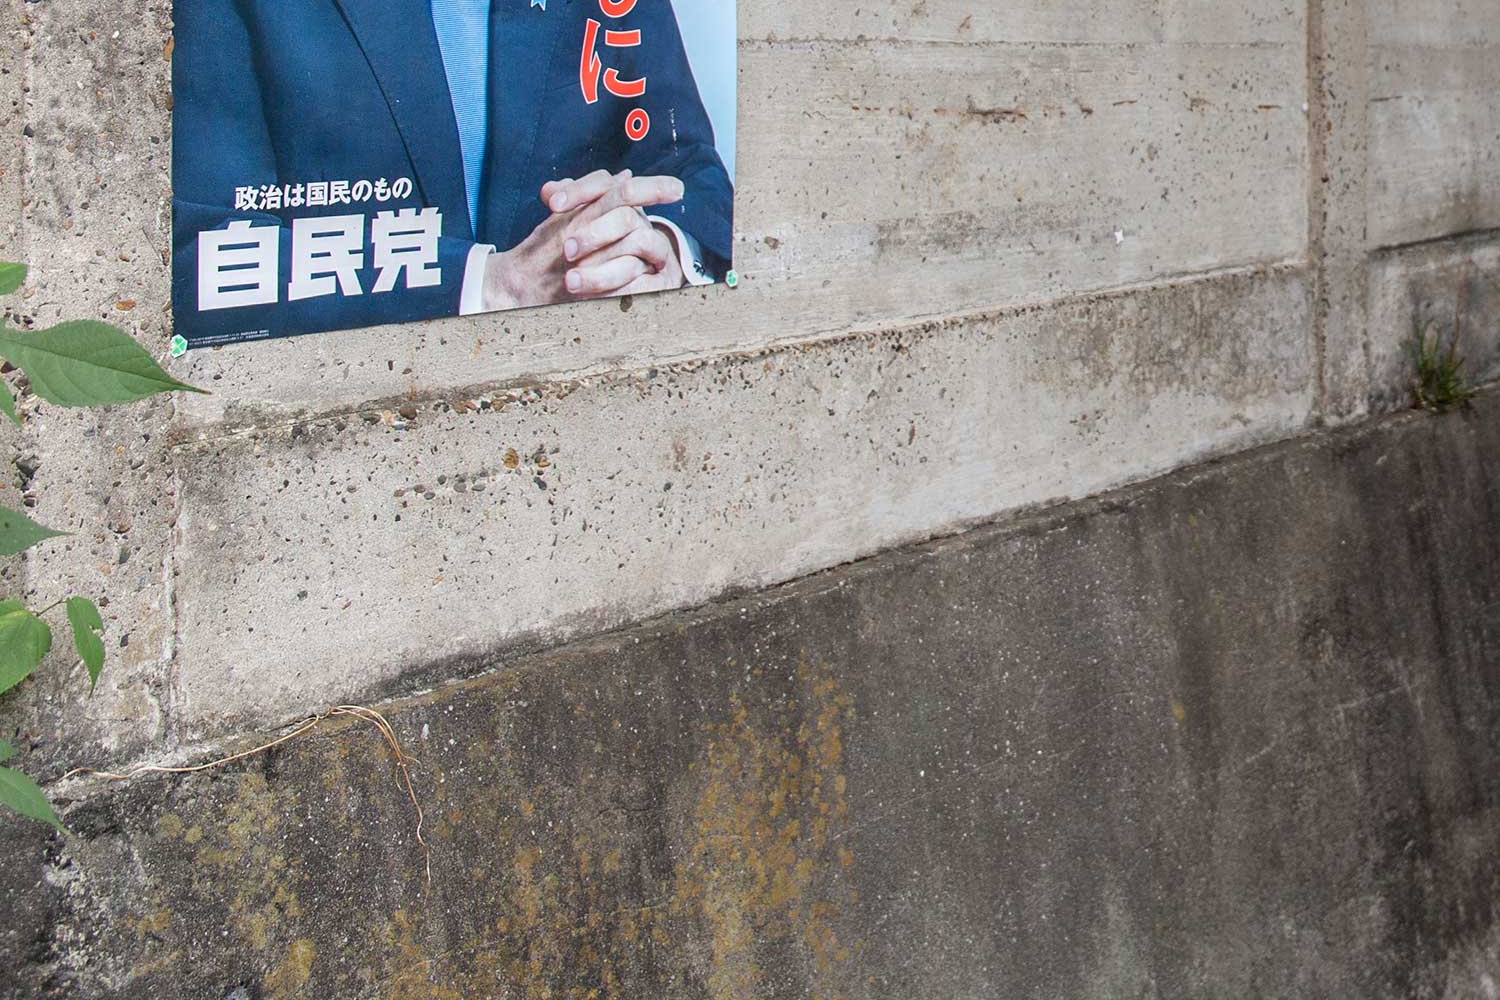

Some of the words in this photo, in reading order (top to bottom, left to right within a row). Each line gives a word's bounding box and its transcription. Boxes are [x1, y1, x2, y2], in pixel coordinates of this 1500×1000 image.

[235, 176, 413, 211] 政治は国民のもの
[197, 206, 443, 312] 自民党
